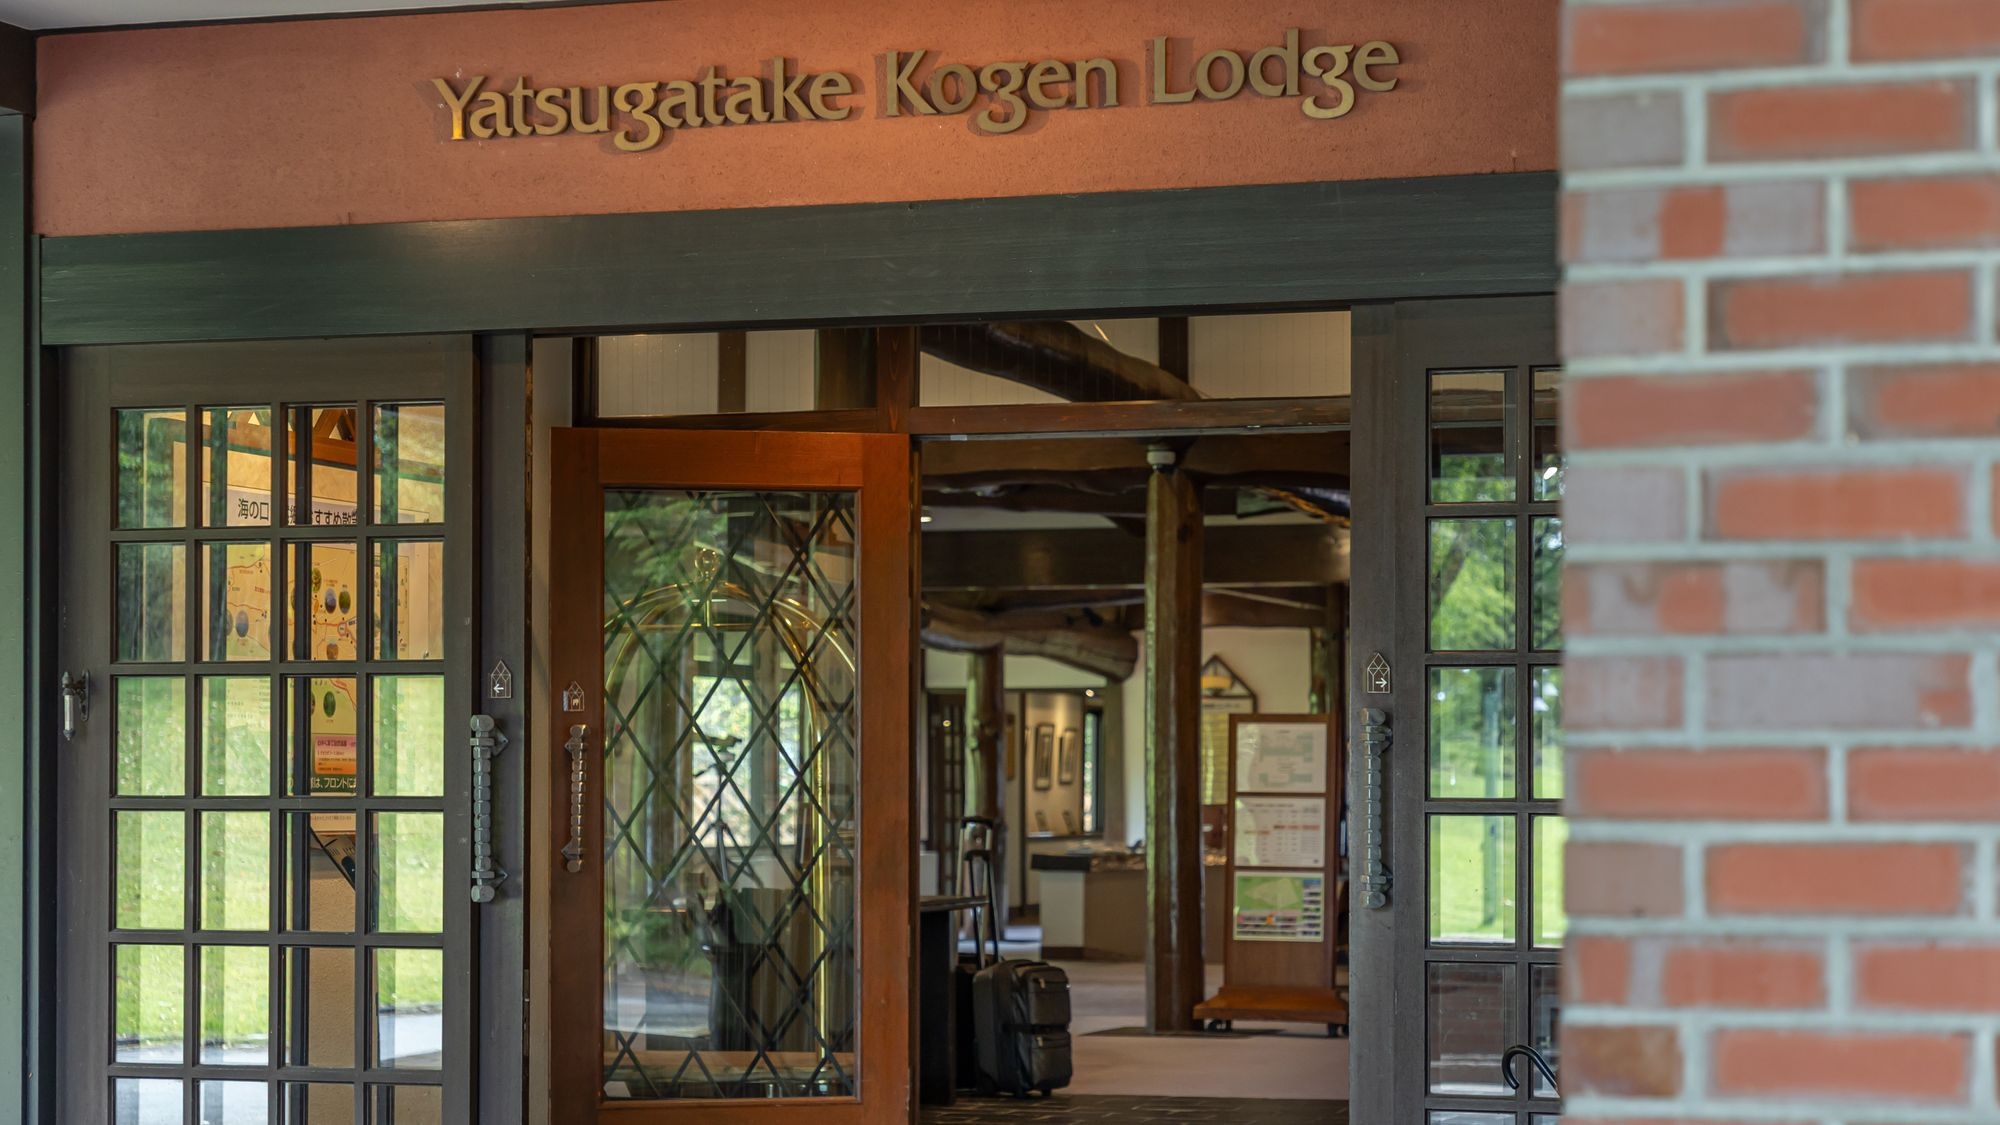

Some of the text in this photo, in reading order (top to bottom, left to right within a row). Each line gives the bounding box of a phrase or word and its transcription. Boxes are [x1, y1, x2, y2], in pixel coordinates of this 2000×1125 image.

[432, 27, 1400, 151] Yatsugatake Kogen Lodge
[238, 498, 270, 520] 海の口
